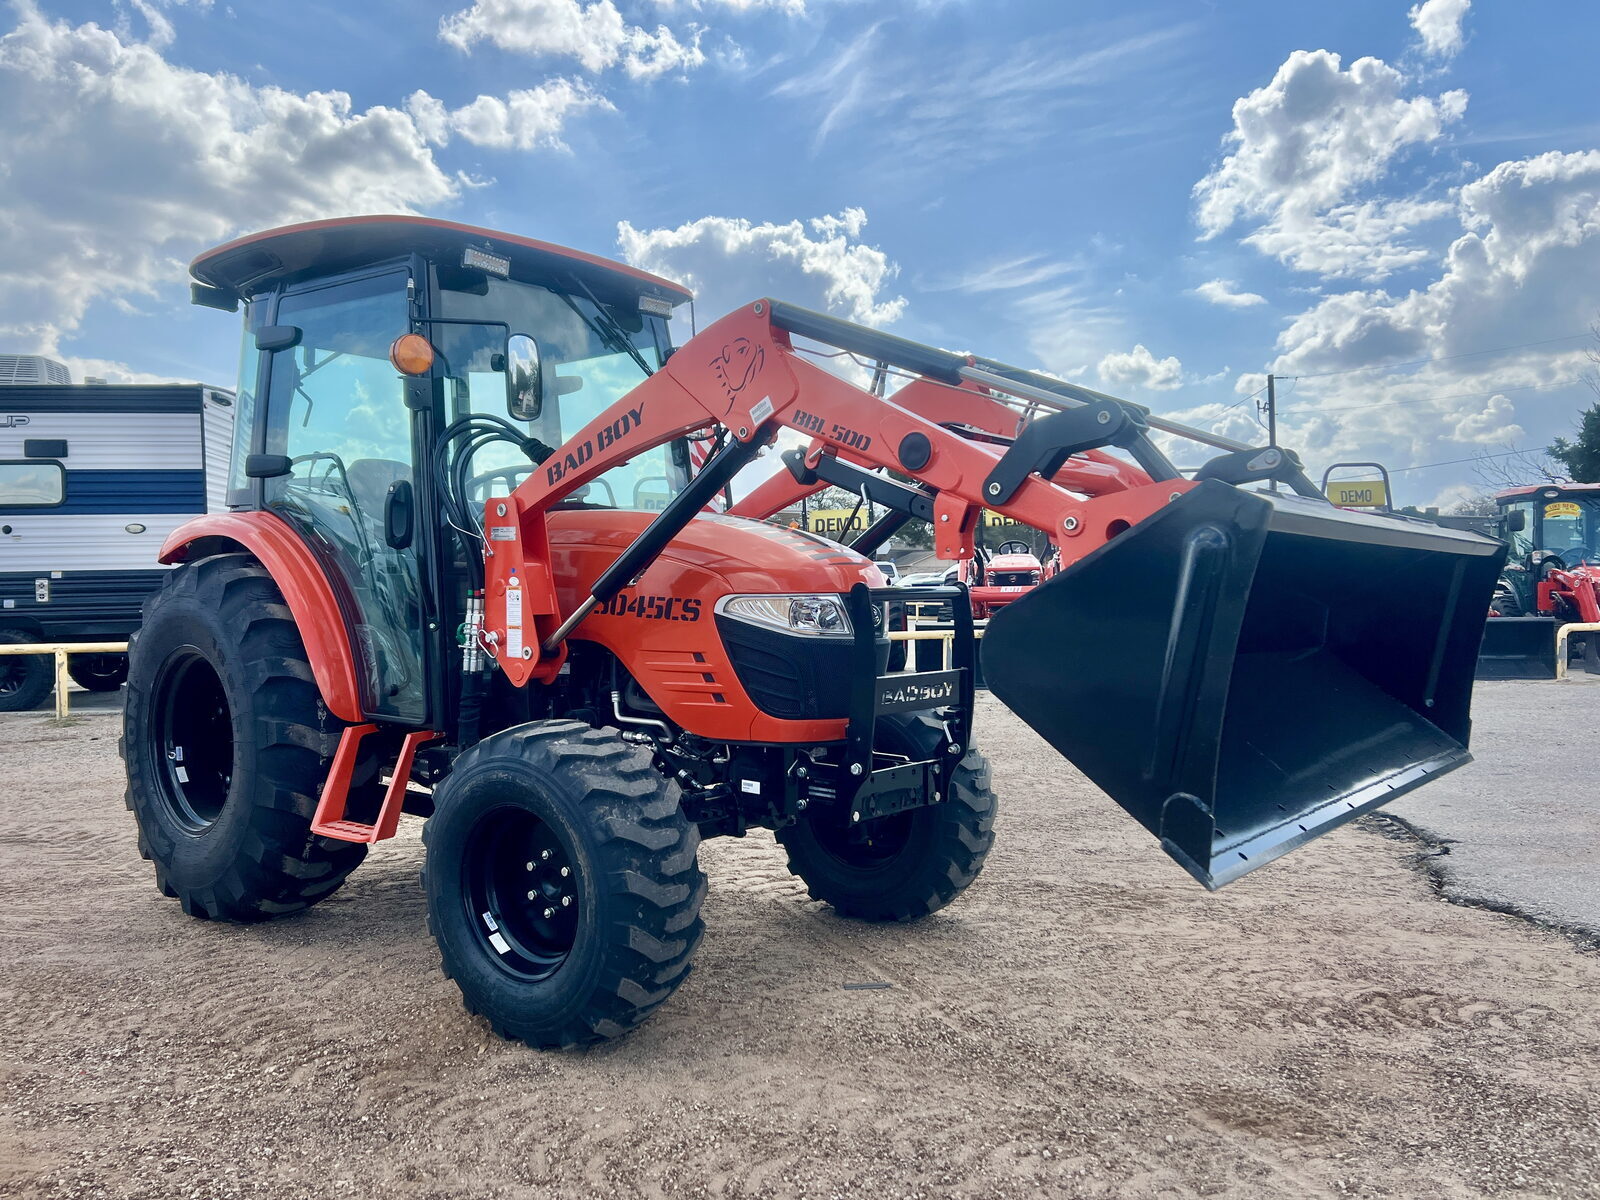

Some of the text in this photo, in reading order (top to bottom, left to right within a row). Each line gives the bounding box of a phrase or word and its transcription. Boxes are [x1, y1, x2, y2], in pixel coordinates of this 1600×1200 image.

[547, 402, 644, 487] BAD BOY
[792, 409, 825, 435] BBL
[829, 424, 872, 451] 500
[1340, 489, 1373, 503] DEMO
[815, 516, 862, 533] DEMO
